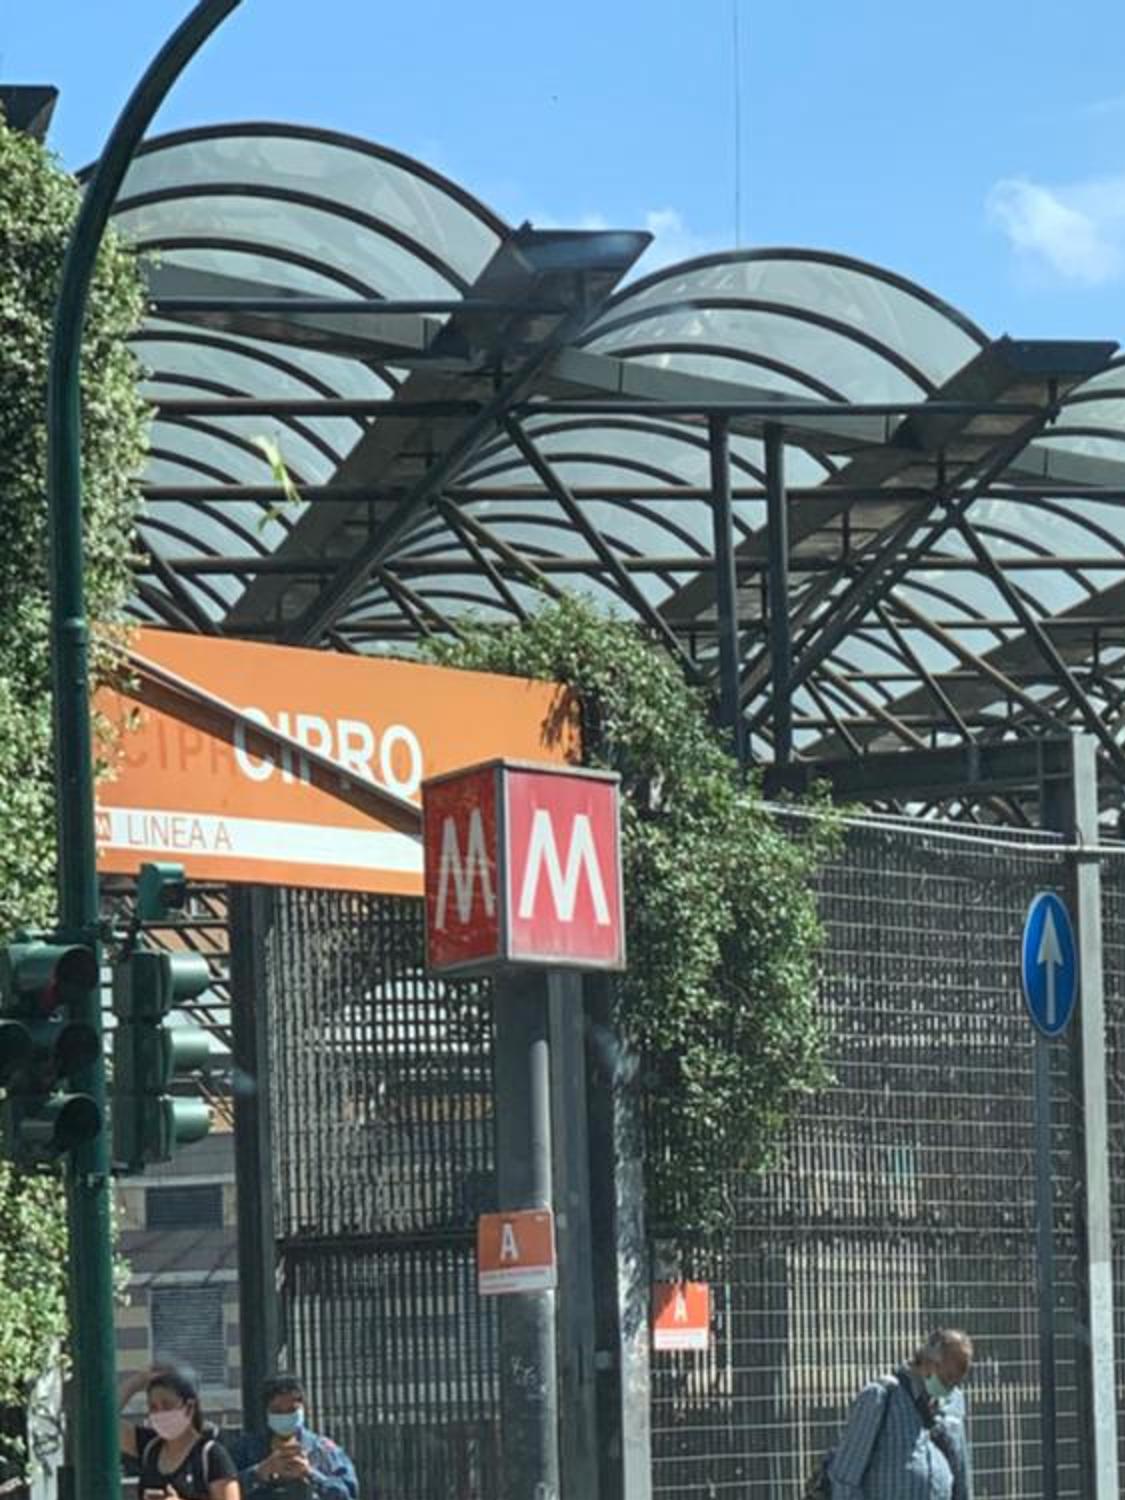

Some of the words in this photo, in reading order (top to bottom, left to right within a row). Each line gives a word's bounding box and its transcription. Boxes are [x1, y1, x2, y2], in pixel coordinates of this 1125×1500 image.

[232, 706, 424, 799] CIPRO
[127, 814, 207, 848] LINEA
[213, 820, 233, 849] A
[435, 808, 497, 931] M
[518, 808, 611, 926] M
[500, 1222, 520, 1262] A
